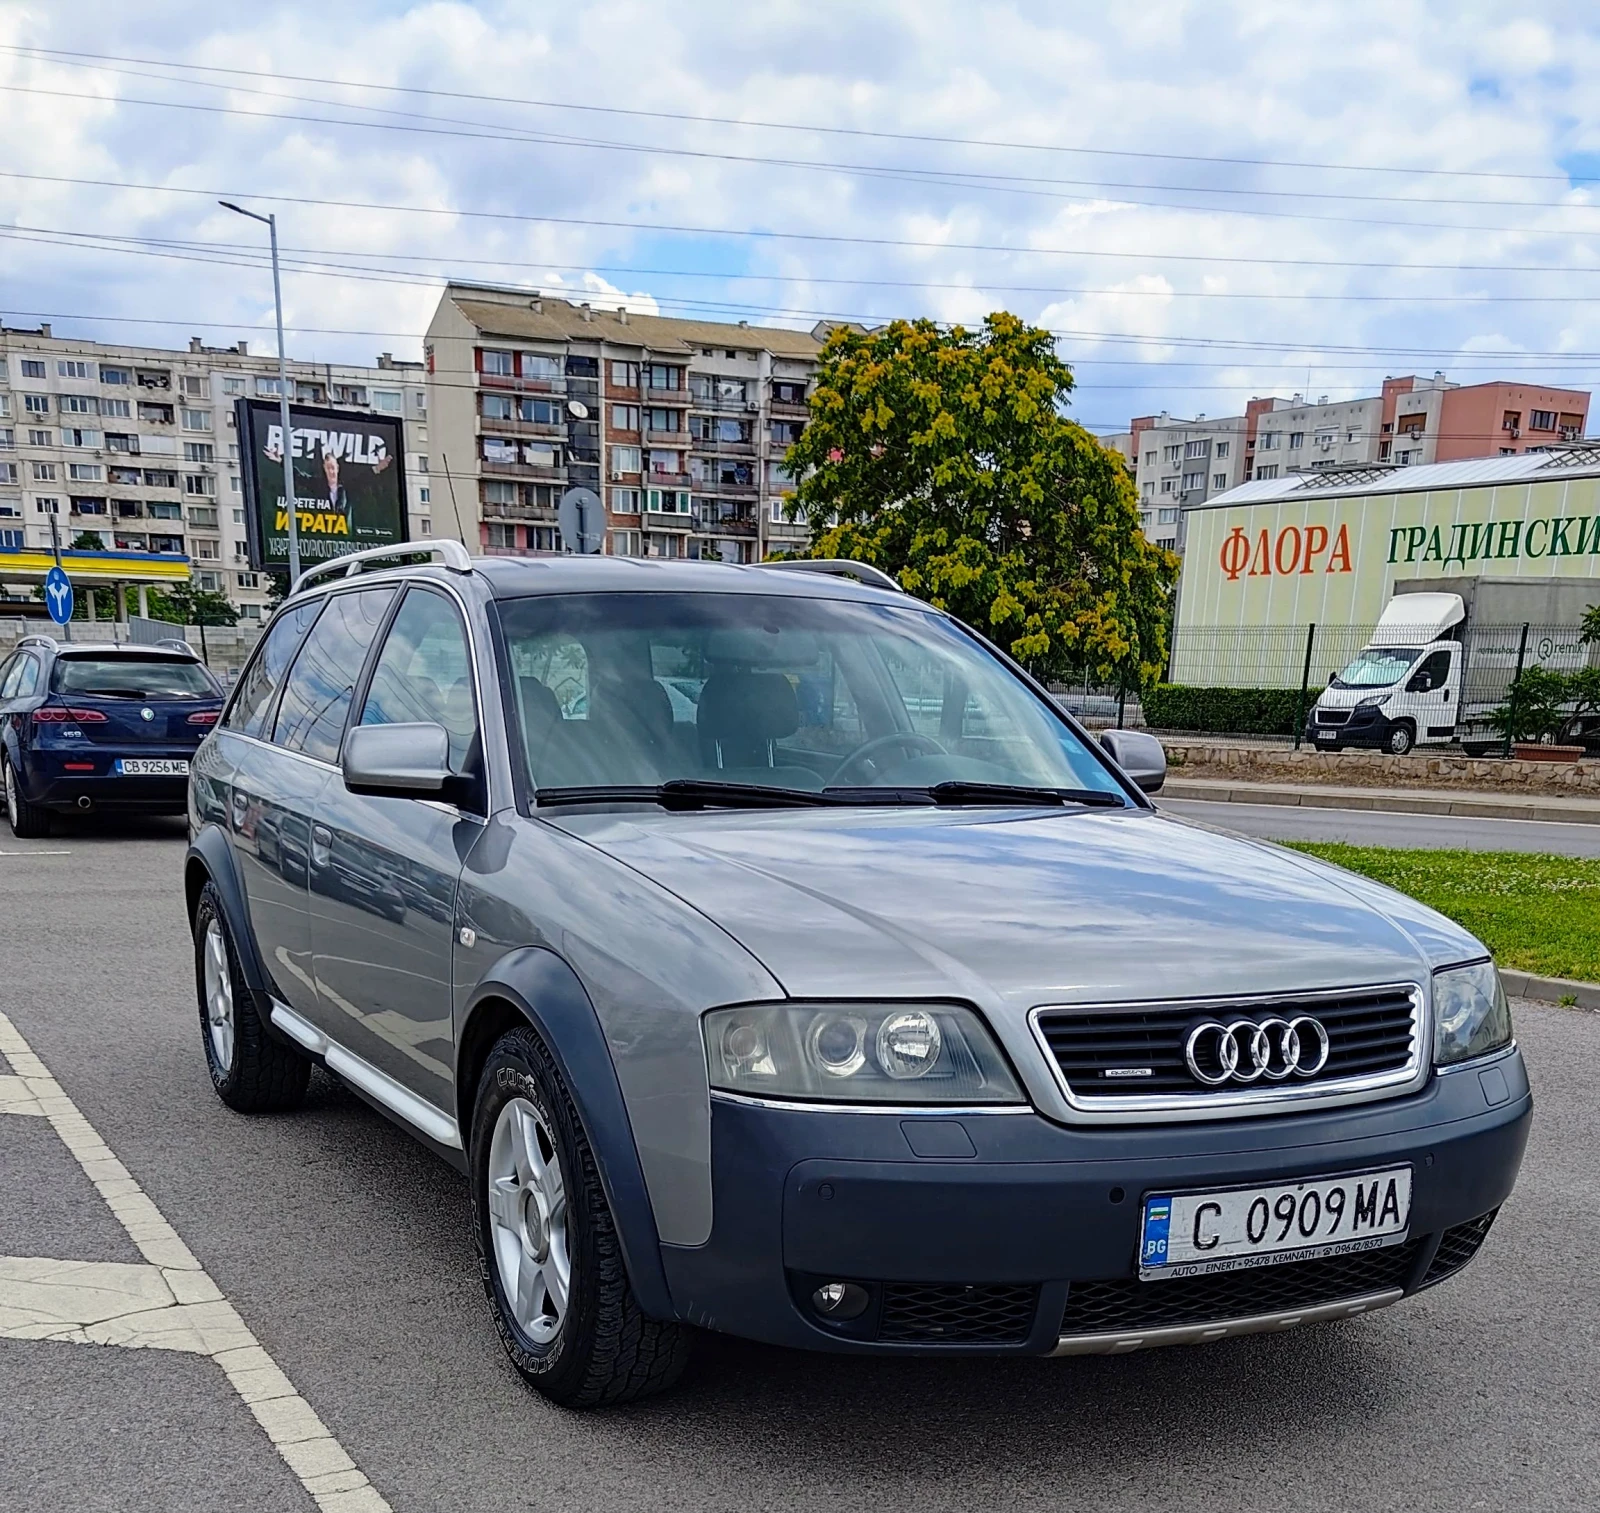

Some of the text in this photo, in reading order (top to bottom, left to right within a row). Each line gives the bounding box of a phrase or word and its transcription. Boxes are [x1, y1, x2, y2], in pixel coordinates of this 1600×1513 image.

[267, 424, 387, 465] BETWILD
[276, 496, 331, 510] ЦРЕТЕ НА
[1219, 523, 1353, 581] ФЛОРА
[1478, 643, 1533, 656] remixshop.cm
[1554, 640, 1584, 654] remix
[124, 761, 188, 774] CB 9256 ME
[1193, 1177, 1401, 1250] C 0909 MA
[1147, 1239, 1167, 1255] BG
[1170, 1238, 1383, 1277] AUTO EINERT 95478 KEMNATH 09642/8573
